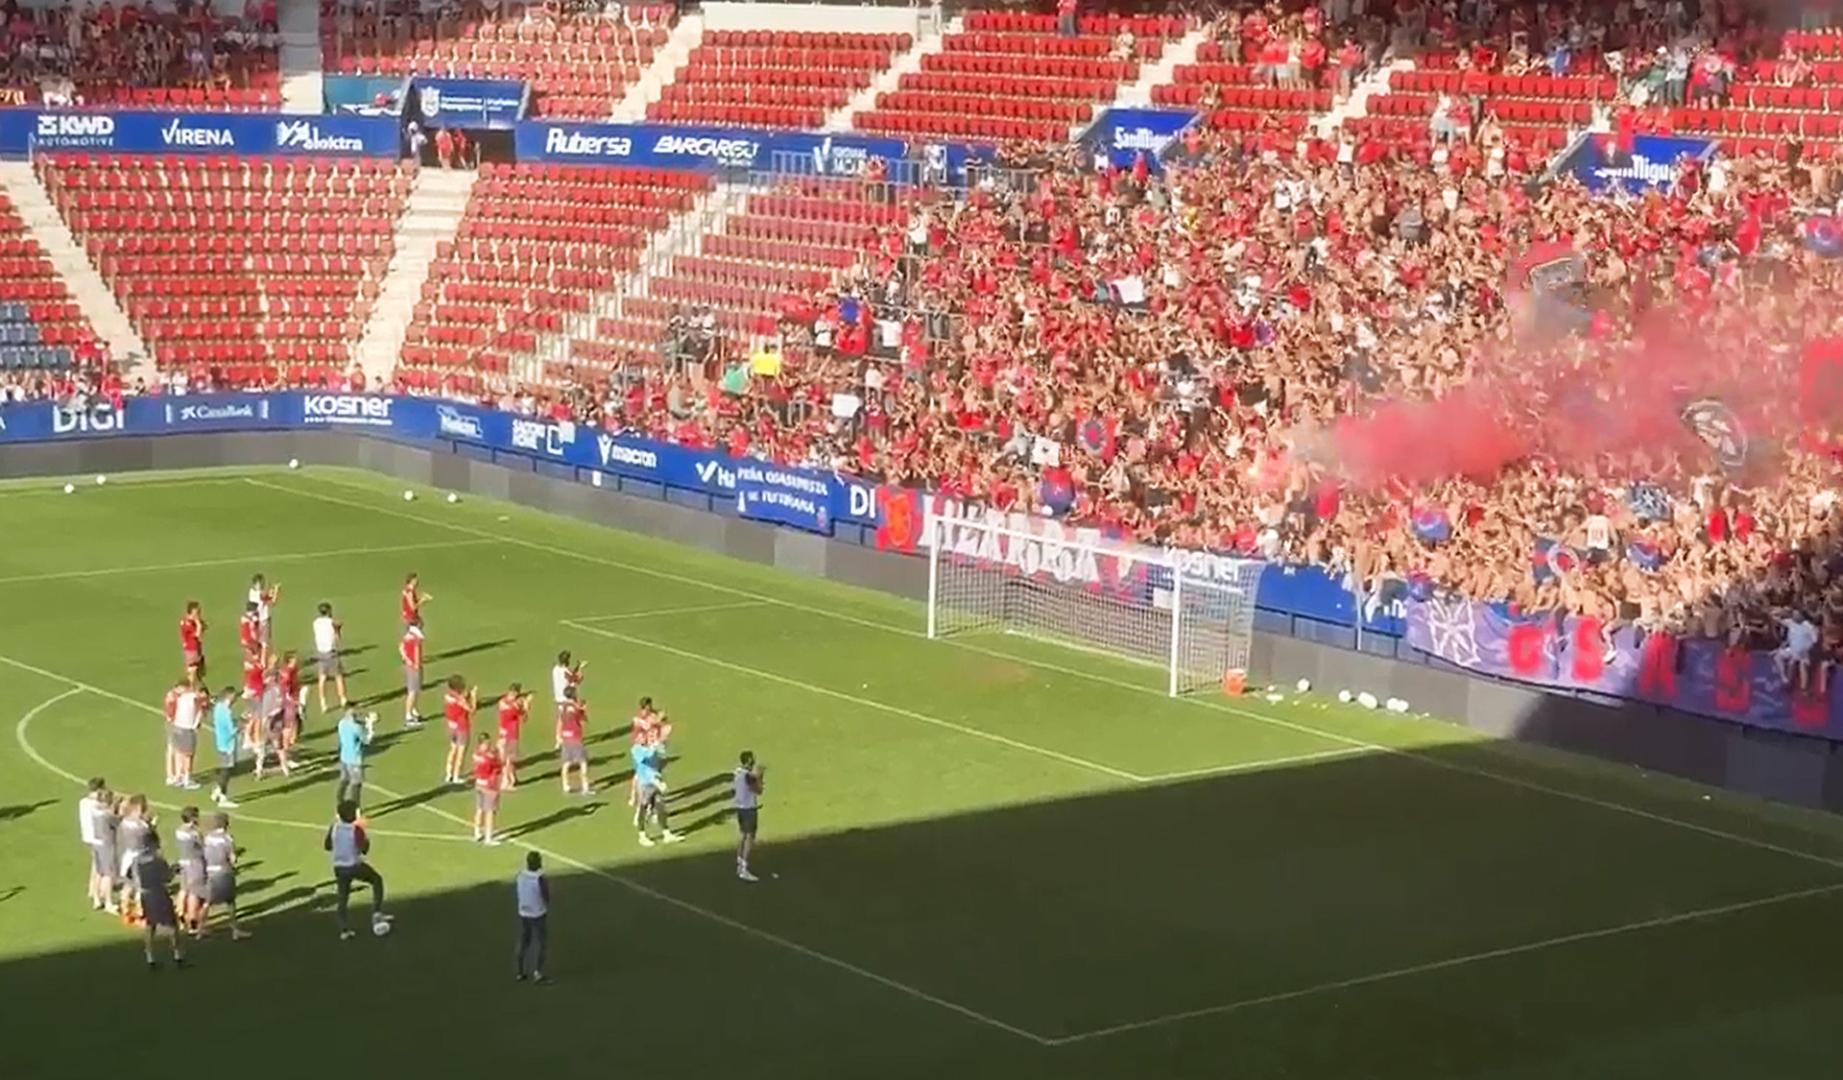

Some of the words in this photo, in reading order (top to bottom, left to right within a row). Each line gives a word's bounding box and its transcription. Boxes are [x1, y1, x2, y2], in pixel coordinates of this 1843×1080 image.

[59, 115, 115, 136] KWD
[161, 118, 235, 146] VIRENA
[53, 404, 124, 433] DIGI
[611, 444, 657, 469] macron
